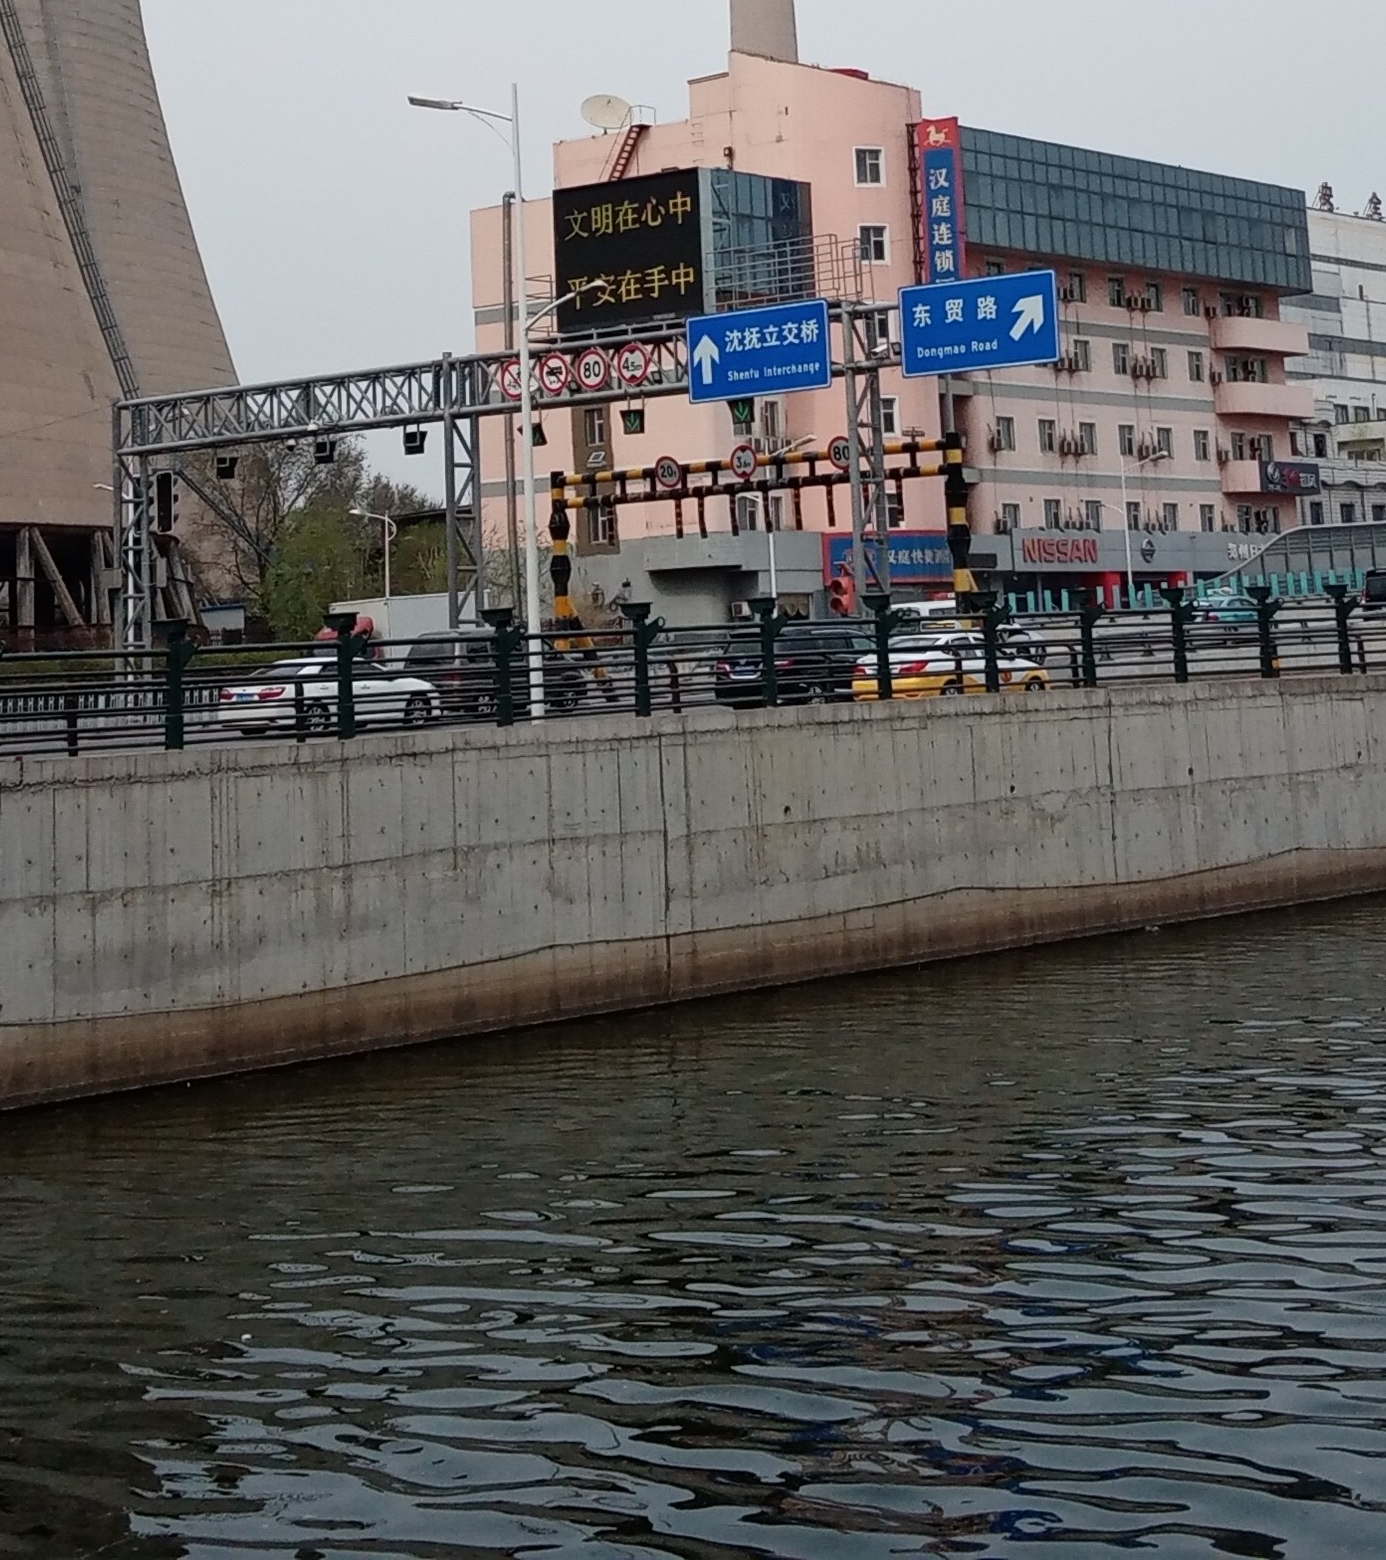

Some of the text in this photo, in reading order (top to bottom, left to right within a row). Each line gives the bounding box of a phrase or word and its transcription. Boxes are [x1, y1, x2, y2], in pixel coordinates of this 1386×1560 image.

[564, 190, 692, 241] 文明在心中
[928, 167, 956, 284] 汉庭连锁
[567, 262, 694, 310] 平安在手中
[912, 295, 998, 328] 东贸路
[724, 318, 819, 353] 沈抚立交桥
[917, 338, 998, 360] Dongmao Road
[583, 360, 601, 379] 80
[727, 361, 821, 382] Shenfu Interchange
[833, 445, 849, 461] 80
[1021, 538, 1099, 564] NISSAN
